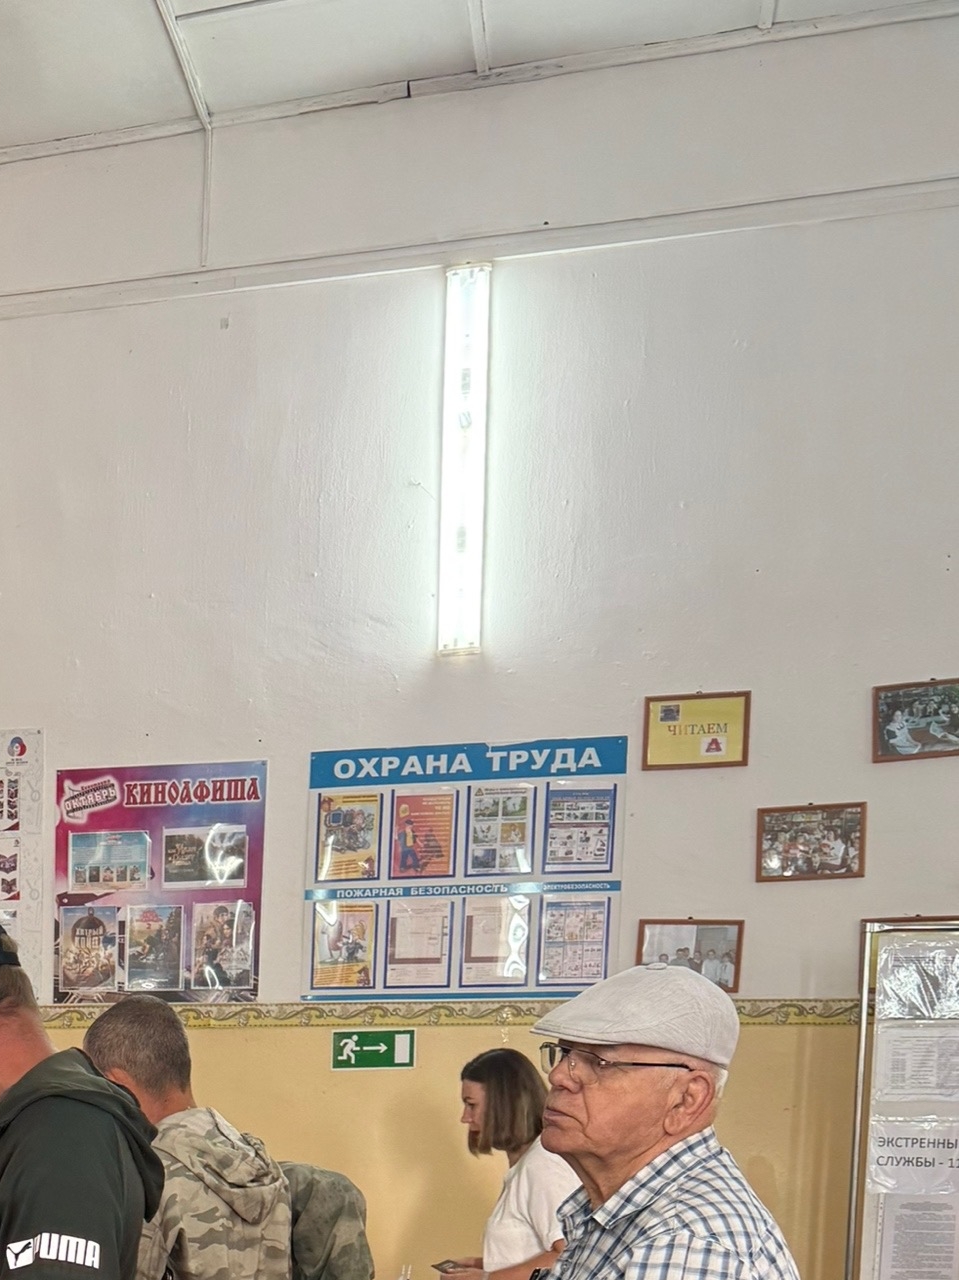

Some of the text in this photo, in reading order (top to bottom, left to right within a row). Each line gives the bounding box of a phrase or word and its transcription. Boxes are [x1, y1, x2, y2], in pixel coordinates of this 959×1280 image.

[667, 723, 728, 736] ЧИТАЕМ
[333, 747, 602, 780] ОХРАНА ТРУДА
[64, 787, 117, 811] ОКТЯБРЬ
[124, 777, 261, 806] КИНОАФИША
[336, 883, 508, 899] ПОЖАРНАЯ БЕЗОПАСНОСТЬ
[877, 1136, 959, 1150] ЭКСТРЕННЫ
[876, 1155, 936, 1168] СЛУЖБЫ
